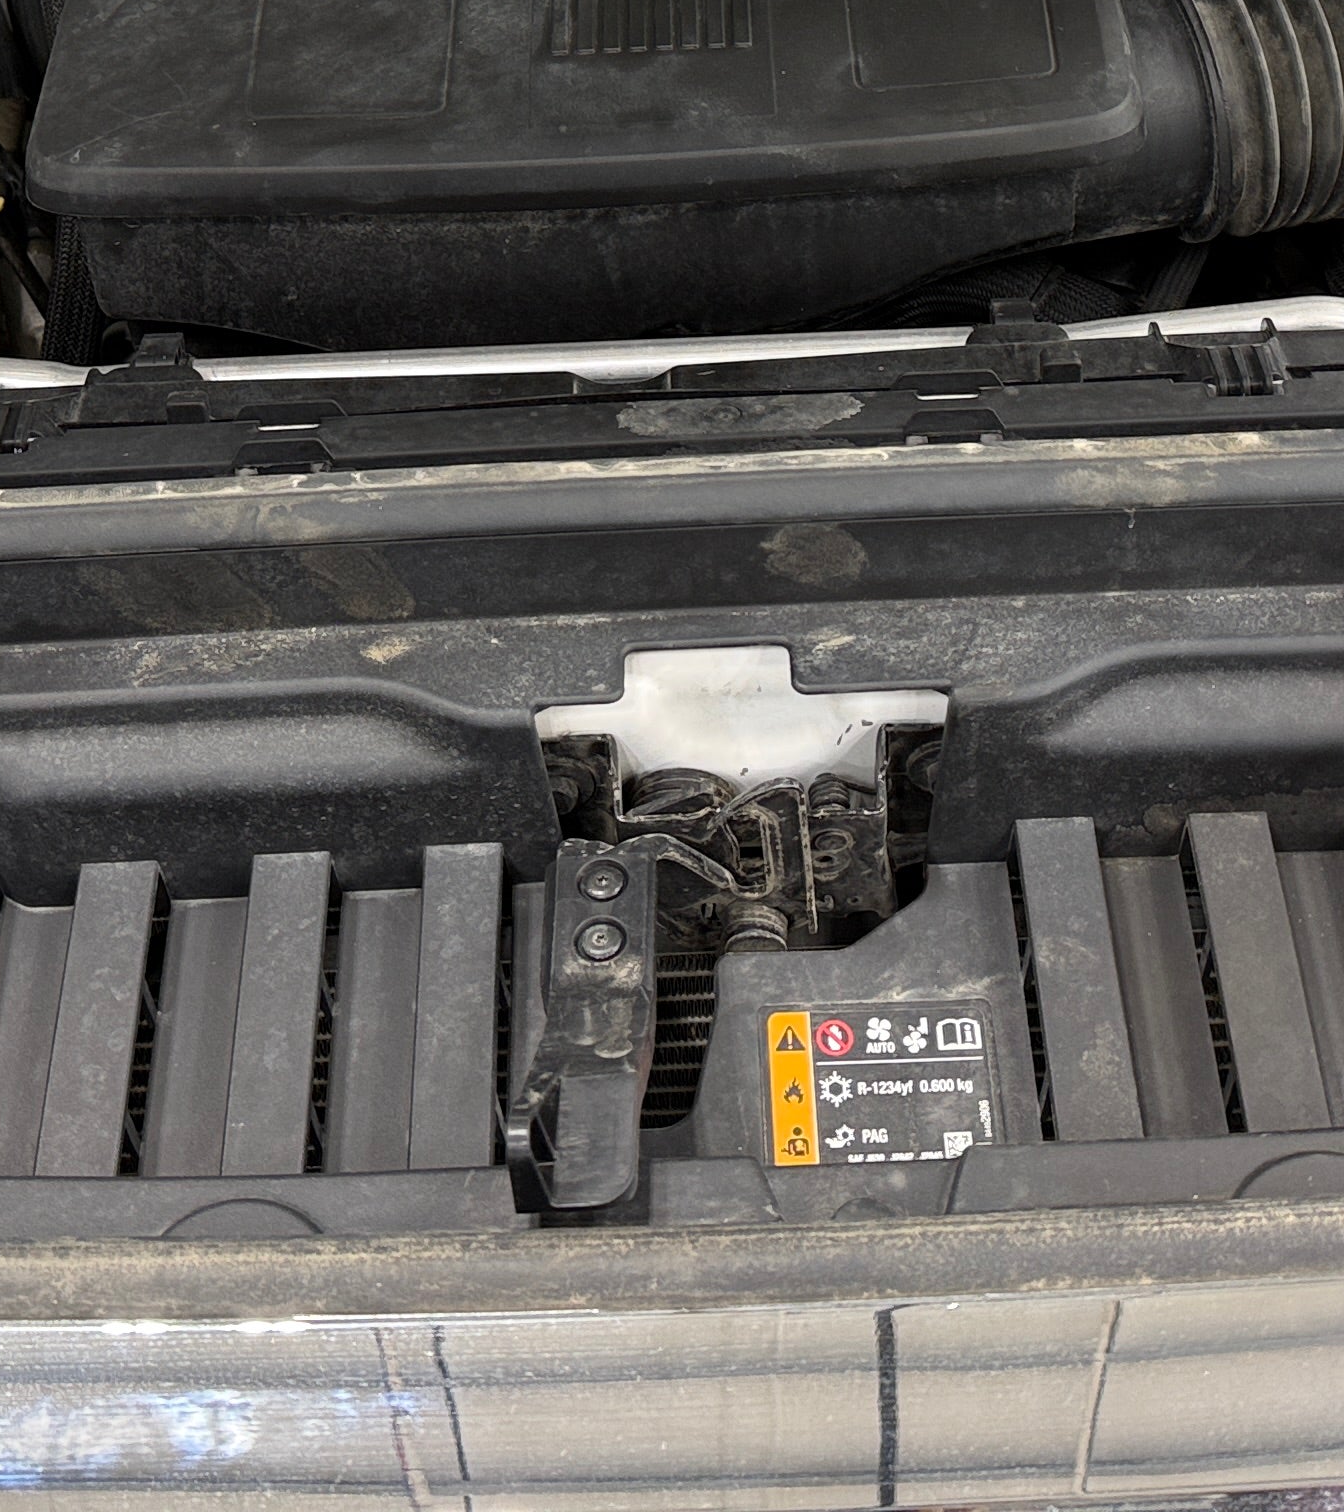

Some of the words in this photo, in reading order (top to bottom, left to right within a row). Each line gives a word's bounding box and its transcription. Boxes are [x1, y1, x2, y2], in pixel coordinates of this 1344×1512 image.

[866, 1042, 896, 1054] AUTO
[857, 1080, 914, 1096] R-1234yf
[919, 1079, 955, 1094] 0.600
[957, 1078, 974, 1094] kg
[862, 1128, 889, 1144] PAG
